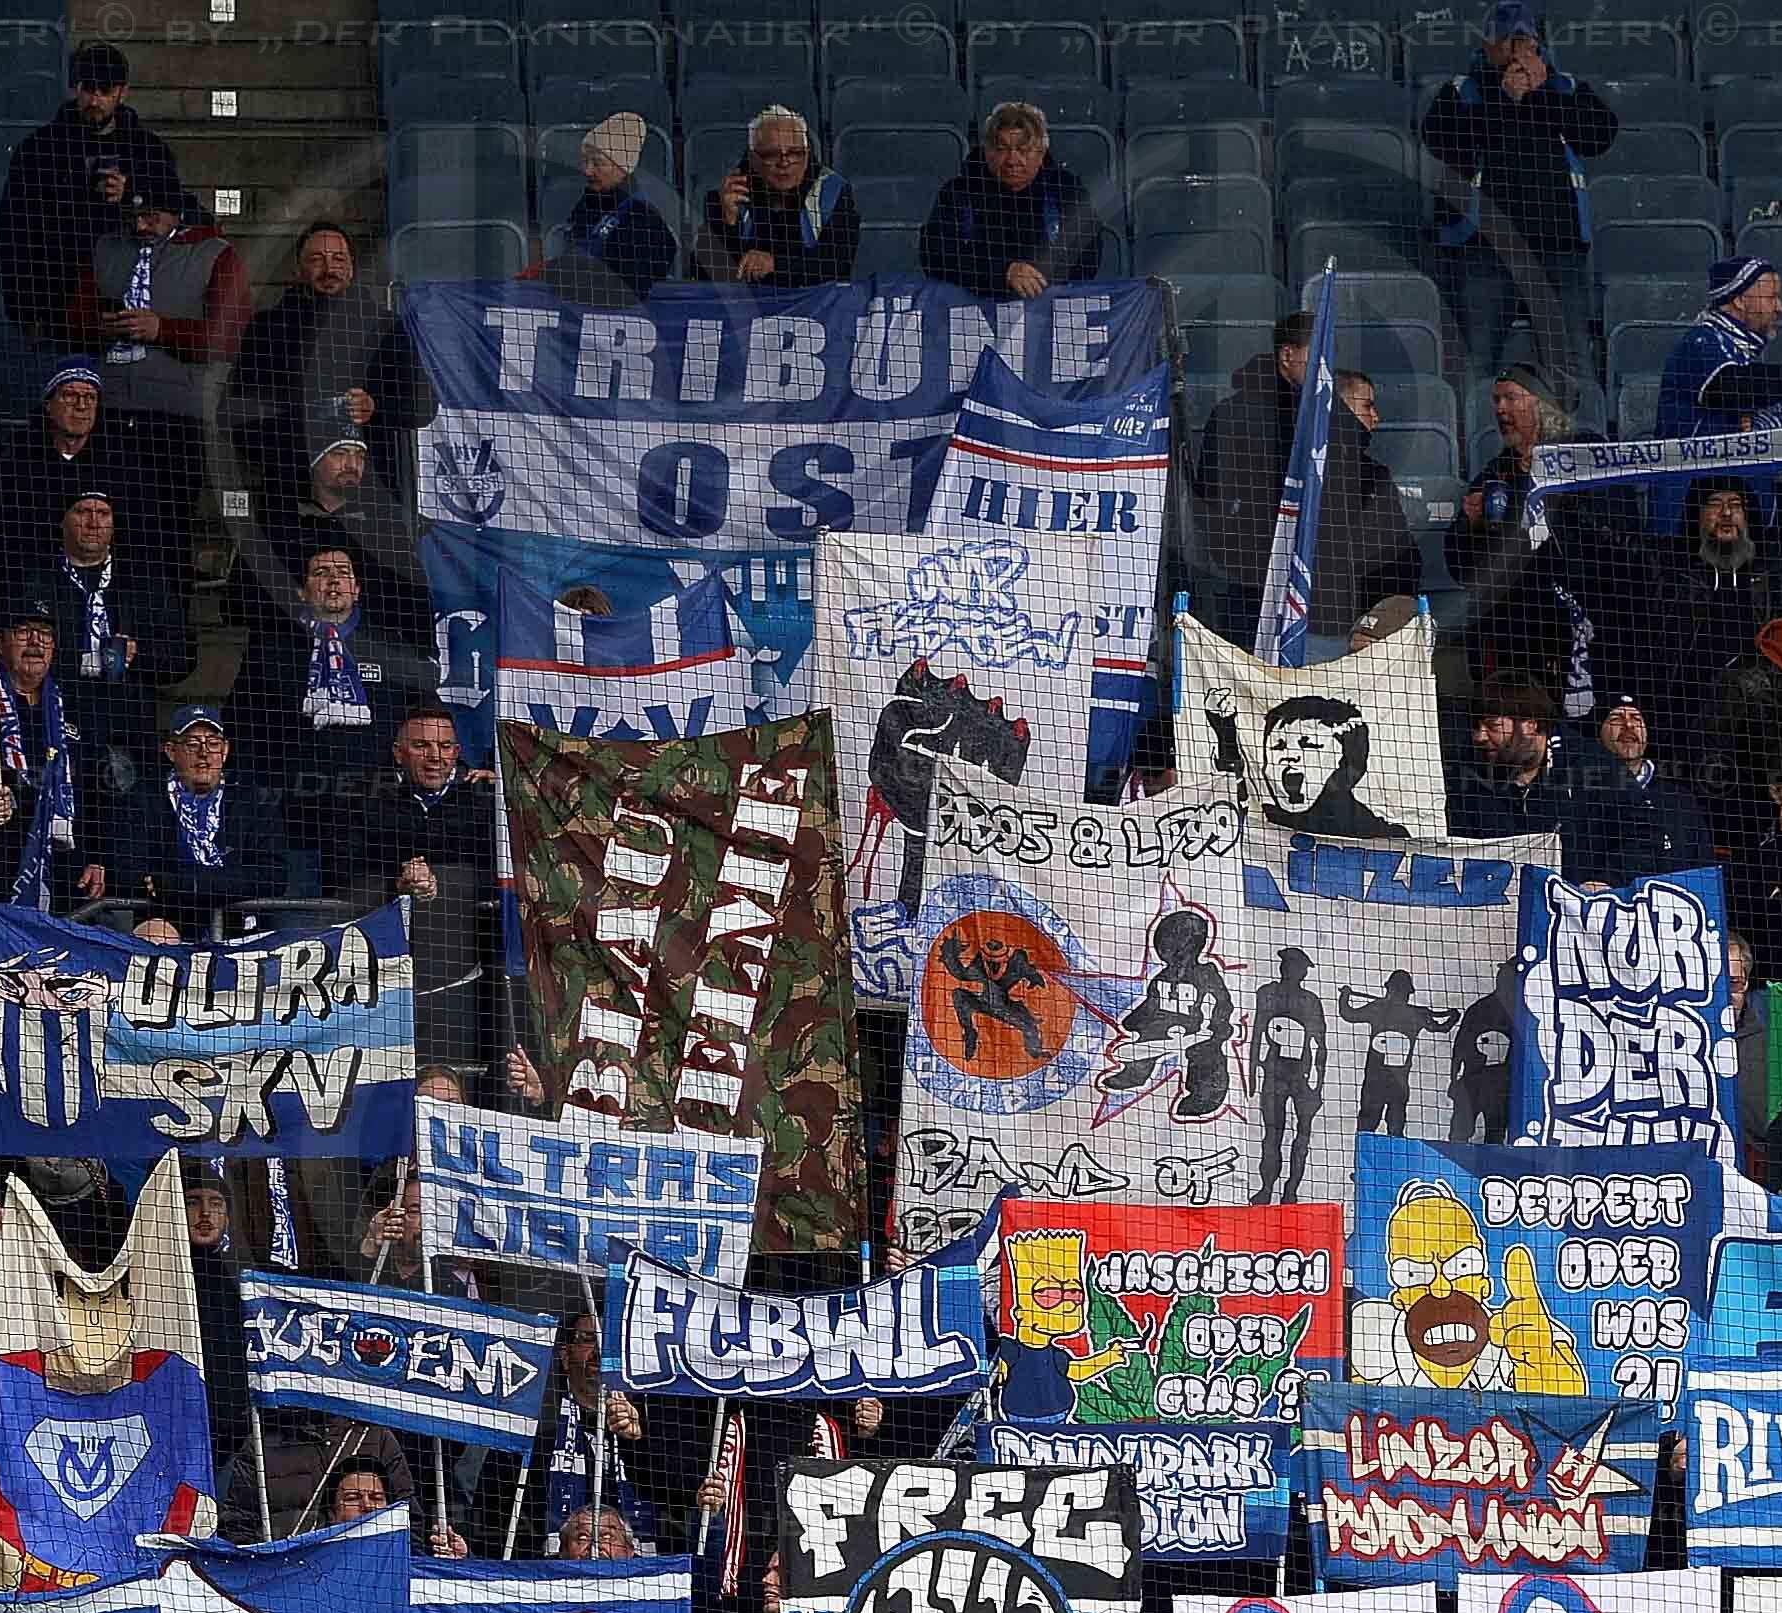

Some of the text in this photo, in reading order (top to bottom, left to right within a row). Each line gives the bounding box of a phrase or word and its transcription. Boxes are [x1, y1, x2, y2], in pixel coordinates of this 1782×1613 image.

[484, 295, 1110, 401] TRIBÜNE
[639, 433, 952, 539] OST
[1542, 450, 1575, 477] FC
[1592, 442, 1663, 471] BLAU
[1678, 433, 1770, 459] WEISS
[961, 474, 1138, 534] HIER
[1070, 816, 1112, 867] &
[123, 925, 379, 1030] ULTRA
[1547, 876, 1720, 1004] NUR
[150, 1046, 363, 1144] SKV
[1548, 1002, 1717, 1116] DER
[430, 1116, 759, 1204] ULTRAS
[1481, 1174, 1691, 1231] DEPPERT
[1557, 1236, 1682, 1294] ODER
[1183, 1314, 1287, 1361] ODER
[1592, 1298, 1689, 1352] WOS
[786, 1464, 1131, 1579] FREE
